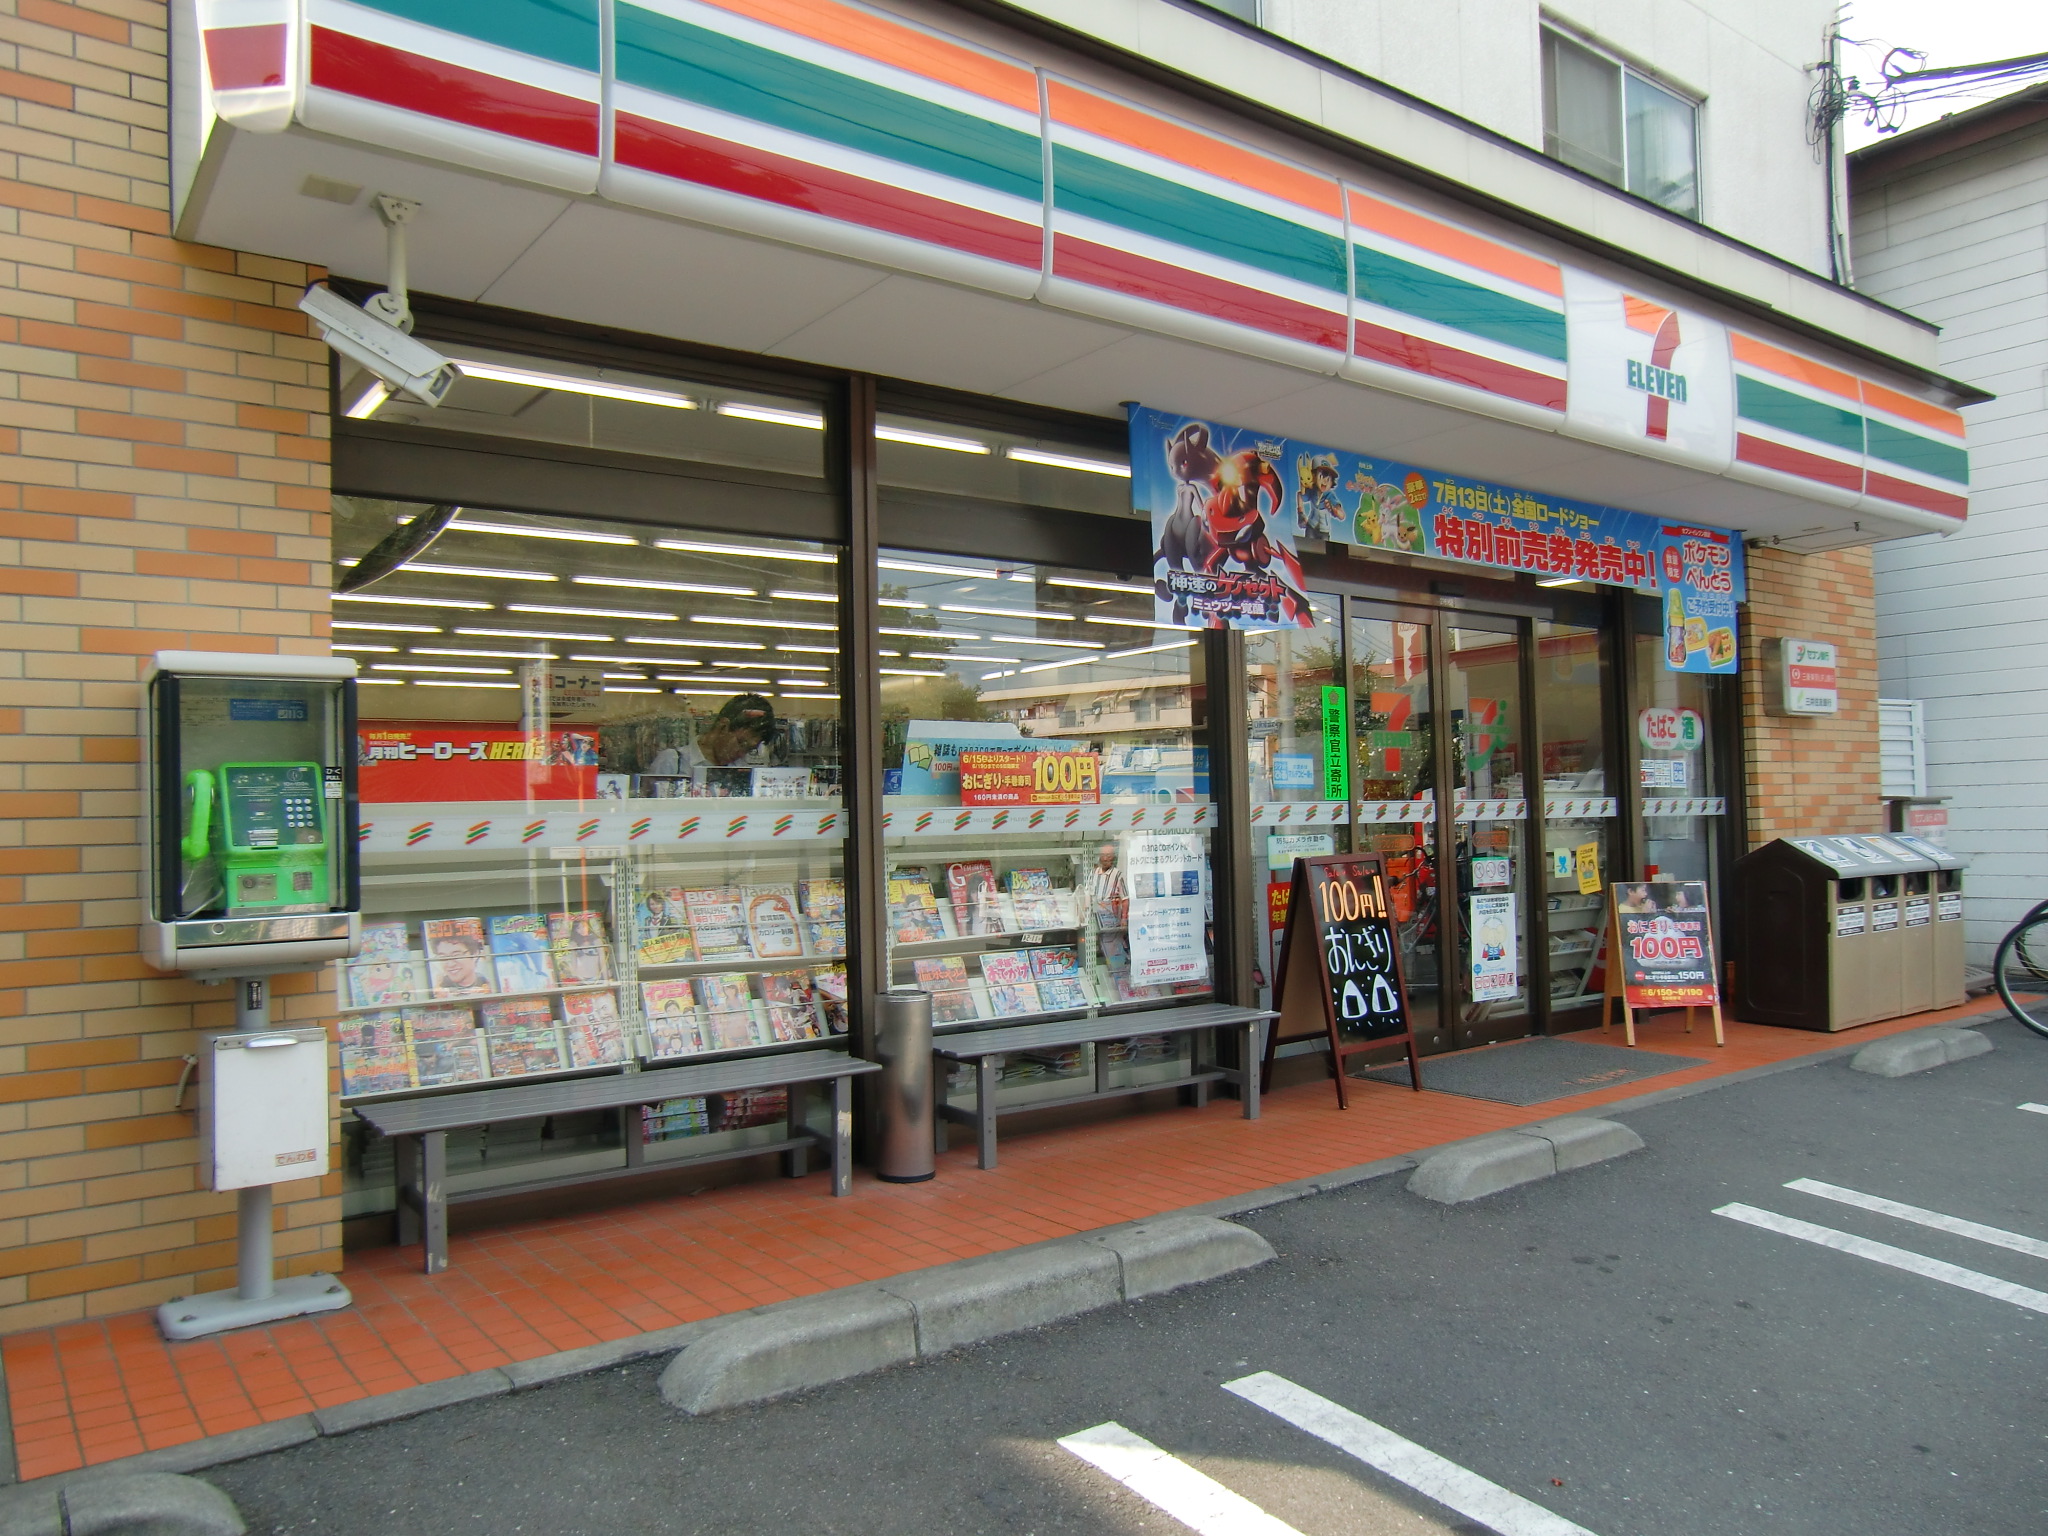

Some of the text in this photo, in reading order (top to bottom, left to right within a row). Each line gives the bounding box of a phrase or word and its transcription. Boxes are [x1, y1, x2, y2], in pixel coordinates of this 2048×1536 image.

[1433, 513, 1659, 589] 特別前売券発売中!
[1682, 539, 1731, 568] ポケモン
[1685, 566, 1733, 594] べんとう
[1646, 713, 1695, 740] たばこ 酒
[368, 741, 489, 760] 月刊ヒーローズ
[1328, 708, 1343, 798] 警察官立寄所
[1032, 755, 1098, 792] 100円
[687, 892, 717, 904] BIG
[1318, 875, 1388, 923] 100円!!
[1324, 924, 1392, 976] おにぎり
[1630, 936, 1704, 959] 100円
[1679, 971, 1705, 980] 150円
